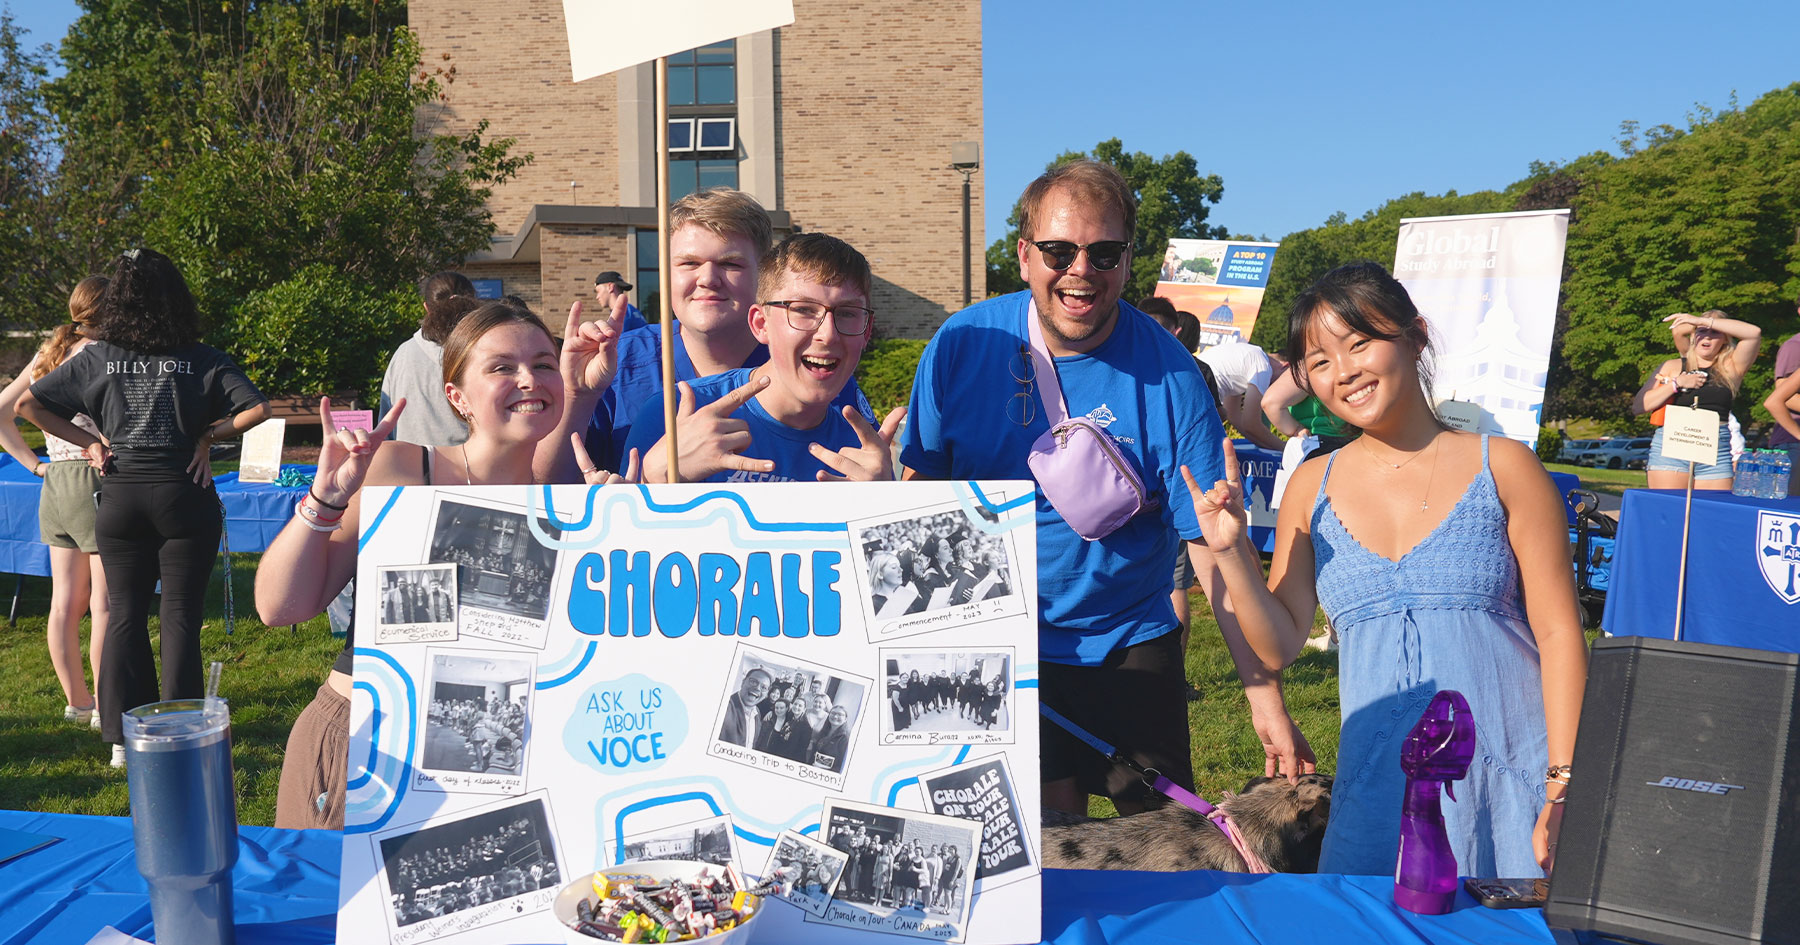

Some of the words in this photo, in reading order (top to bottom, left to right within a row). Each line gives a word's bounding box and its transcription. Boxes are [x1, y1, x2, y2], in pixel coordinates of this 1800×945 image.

[1404, 226, 1500, 255] Global
[1240, 251, 1256, 259] TOP
[1257, 252, 1266, 260] 10
[1228, 265, 1262, 273] PROGRAM
[106, 361, 150, 375] BILLY
[157, 360, 194, 377] JOEL
[1448, 415, 1471, 424] ABROAD
[1674, 431, 1705, 440] DEVELOPMENT
[1696, 440, 1712, 448] CENTER
[1238, 460, 1274, 478] OME
[568, 549, 841, 638] CHORALE
[963, 603, 980, 611] MAY
[463, 608, 505, 624] Considering
[510, 616, 542, 629] Matthew
[881, 612, 952, 634] Commencement
[380, 625, 428, 640] Ecumenical
[408, 630, 449, 641] Service
[466, 623, 494, 636] FALL
[501, 632, 522, 641] 2022
[586, 690, 624, 714] ASK
[640, 687, 662, 709] US
[603, 710, 655, 734] ABOUT
[884, 733, 922, 744] Carmina
[928, 732, 958, 745] Burana
[587, 732, 666, 768] VOCE
[713, 743, 757, 765] Conducting
[762, 755, 780, 768] Trip
[784, 762, 795, 771] to
[798, 765, 842, 786] Boston!
[442, 775, 458, 786] day
[464, 776, 471, 787] of
[933, 768, 1000, 805] CHORALE
[1657, 776, 1733, 795] BOSE
[943, 804, 966, 817] ON
[968, 787, 1003, 816] TOUR
[983, 812, 1012, 839] OUR
[981, 822, 1018, 854] RALE
[982, 839, 1022, 869] TOUR
[789, 892, 809, 905] Park
[827, 907, 856, 922] Chorale
[858, 916, 867, 925] on
[867, 913, 886, 926] Tour
[894, 916, 931, 932] CANADA
